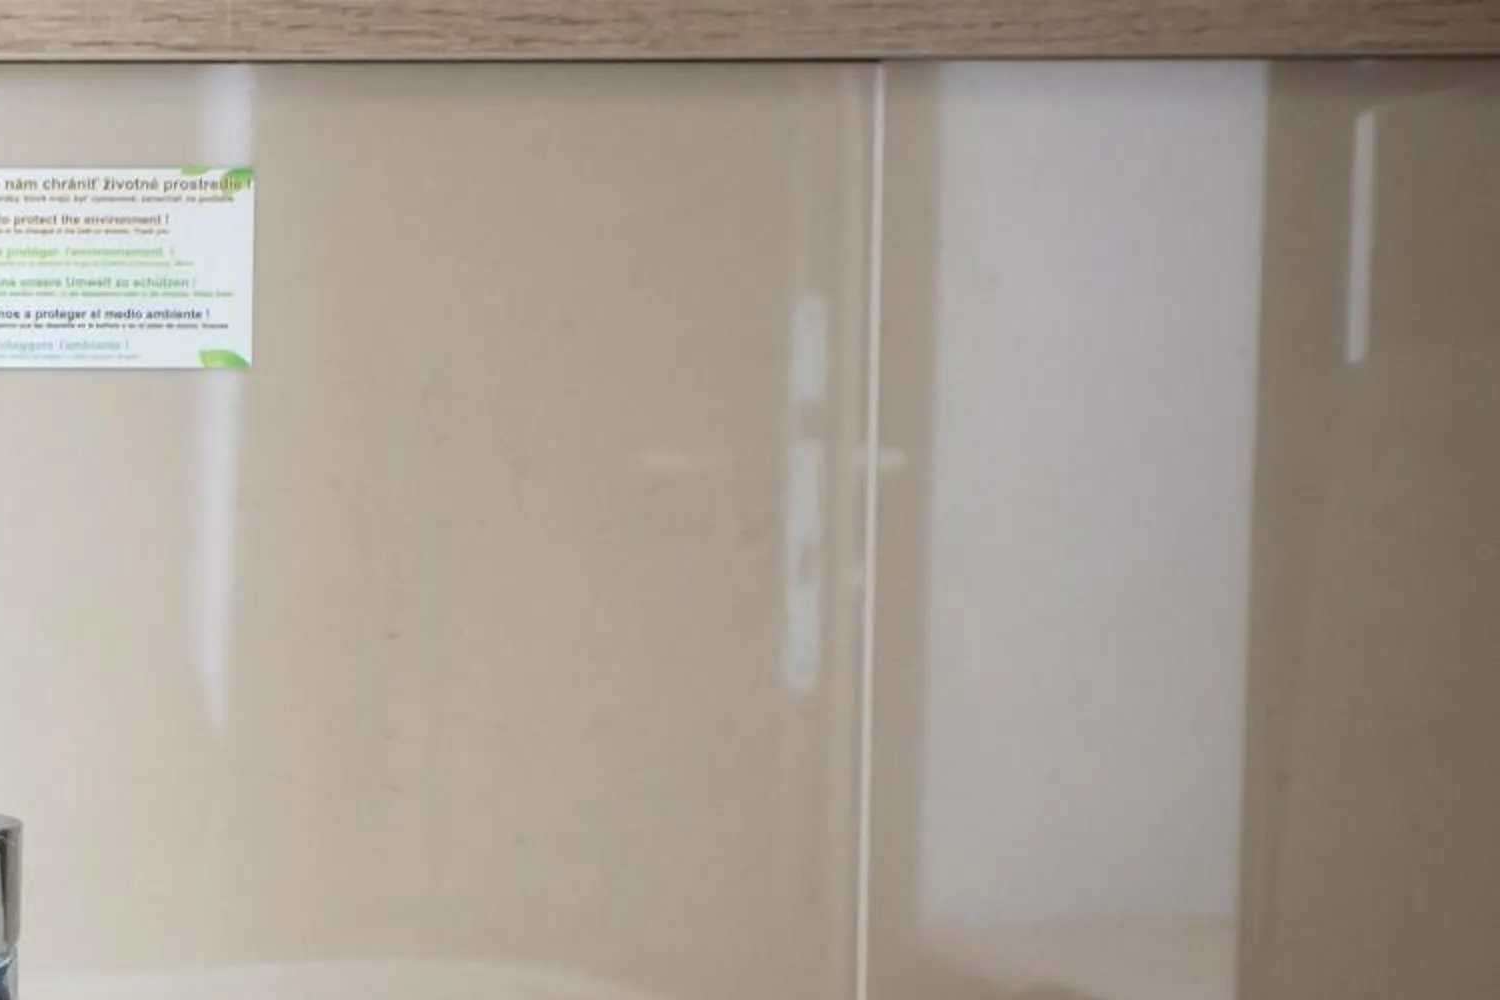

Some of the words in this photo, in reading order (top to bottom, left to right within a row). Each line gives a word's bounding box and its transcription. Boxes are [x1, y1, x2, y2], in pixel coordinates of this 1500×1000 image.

[4, 176, 38, 191] nám
[14, 213, 57, 228] protect
[61, 213, 81, 225] the
[84, 213, 162, 225] environment
[35, 307, 87, 322] proteger
[104, 308, 143, 320] medio
[146, 307, 203, 320] ambiente
